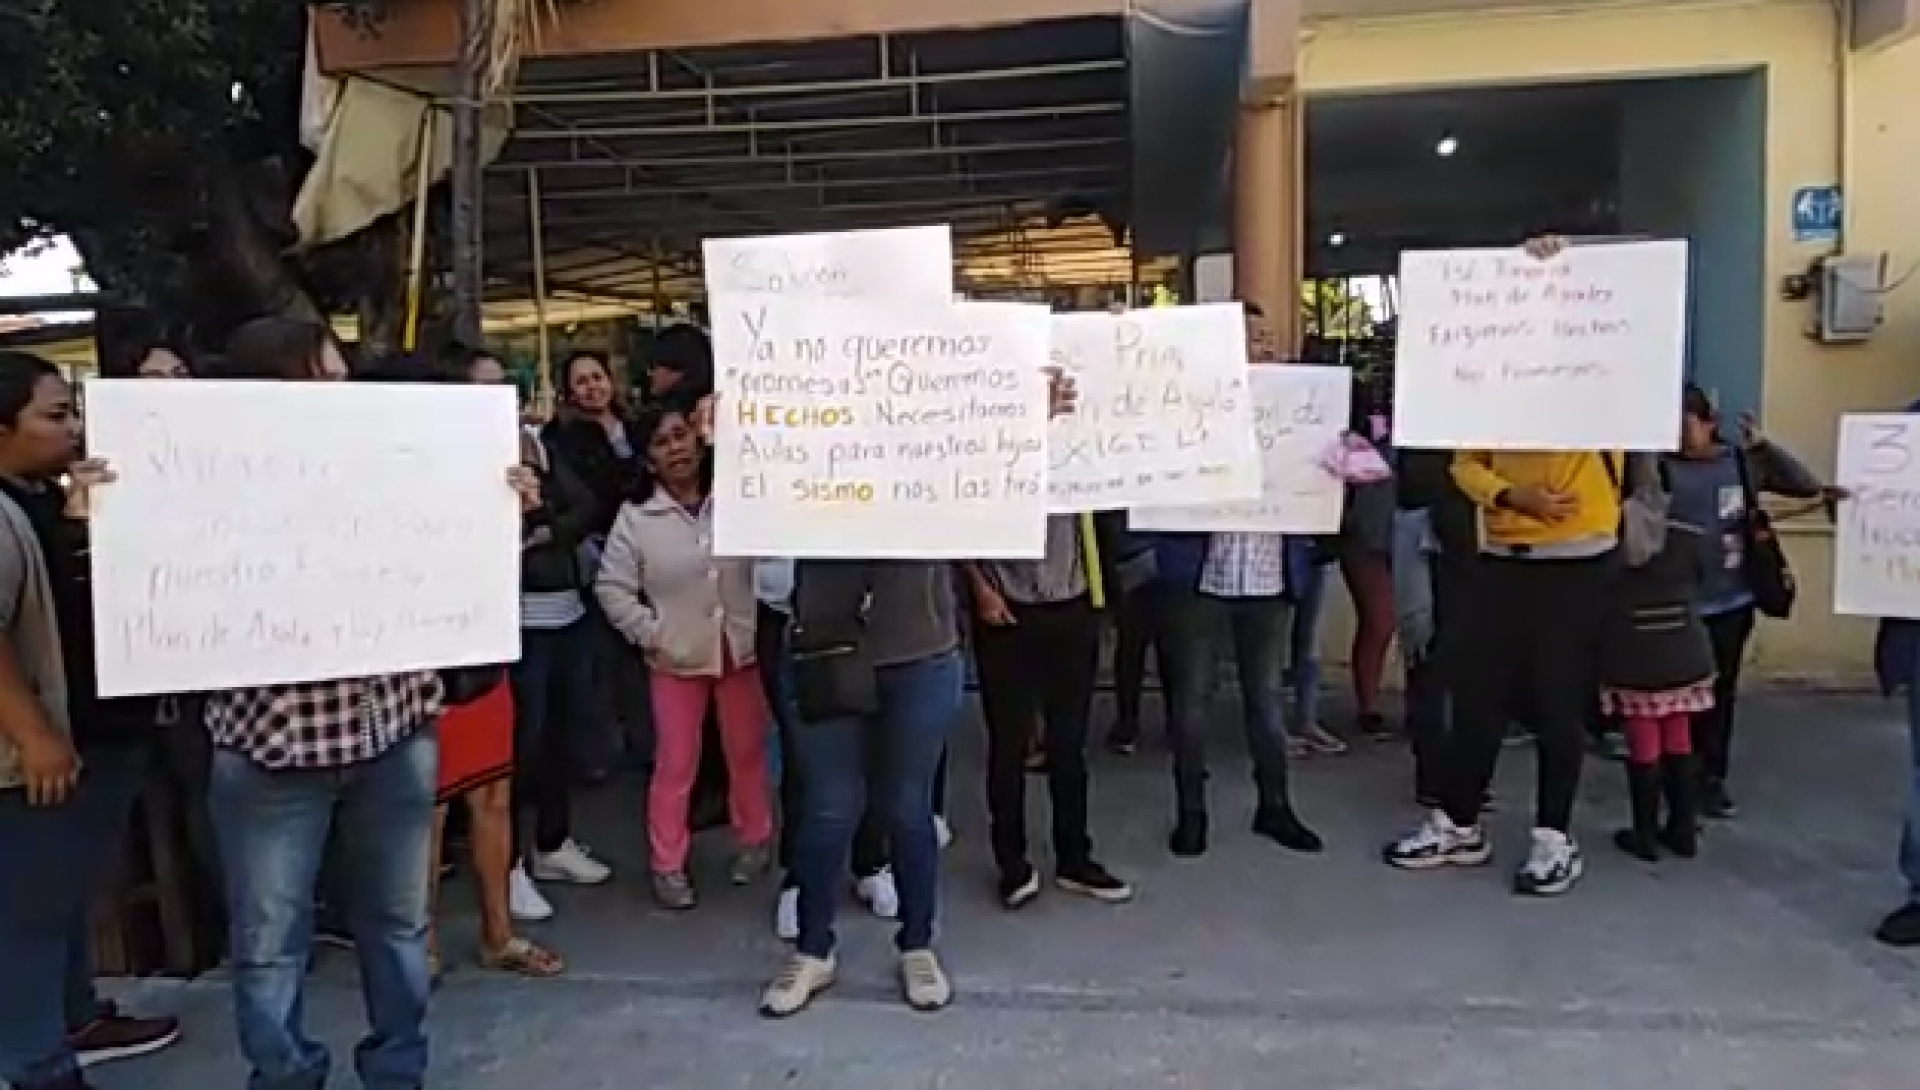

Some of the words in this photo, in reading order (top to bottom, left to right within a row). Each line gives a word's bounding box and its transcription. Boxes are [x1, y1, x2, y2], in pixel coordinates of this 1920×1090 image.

[740, 304, 776, 362] Ya
[796, 337, 827, 365] no
[841, 333, 991, 379] queremos
[875, 396, 1027, 426] Necesitamos
[738, 432, 809, 464] Aulas
[829, 443, 886, 479] para
[740, 472, 767, 500] El
[893, 481, 937, 502] nos
[954, 471, 990, 500] las
